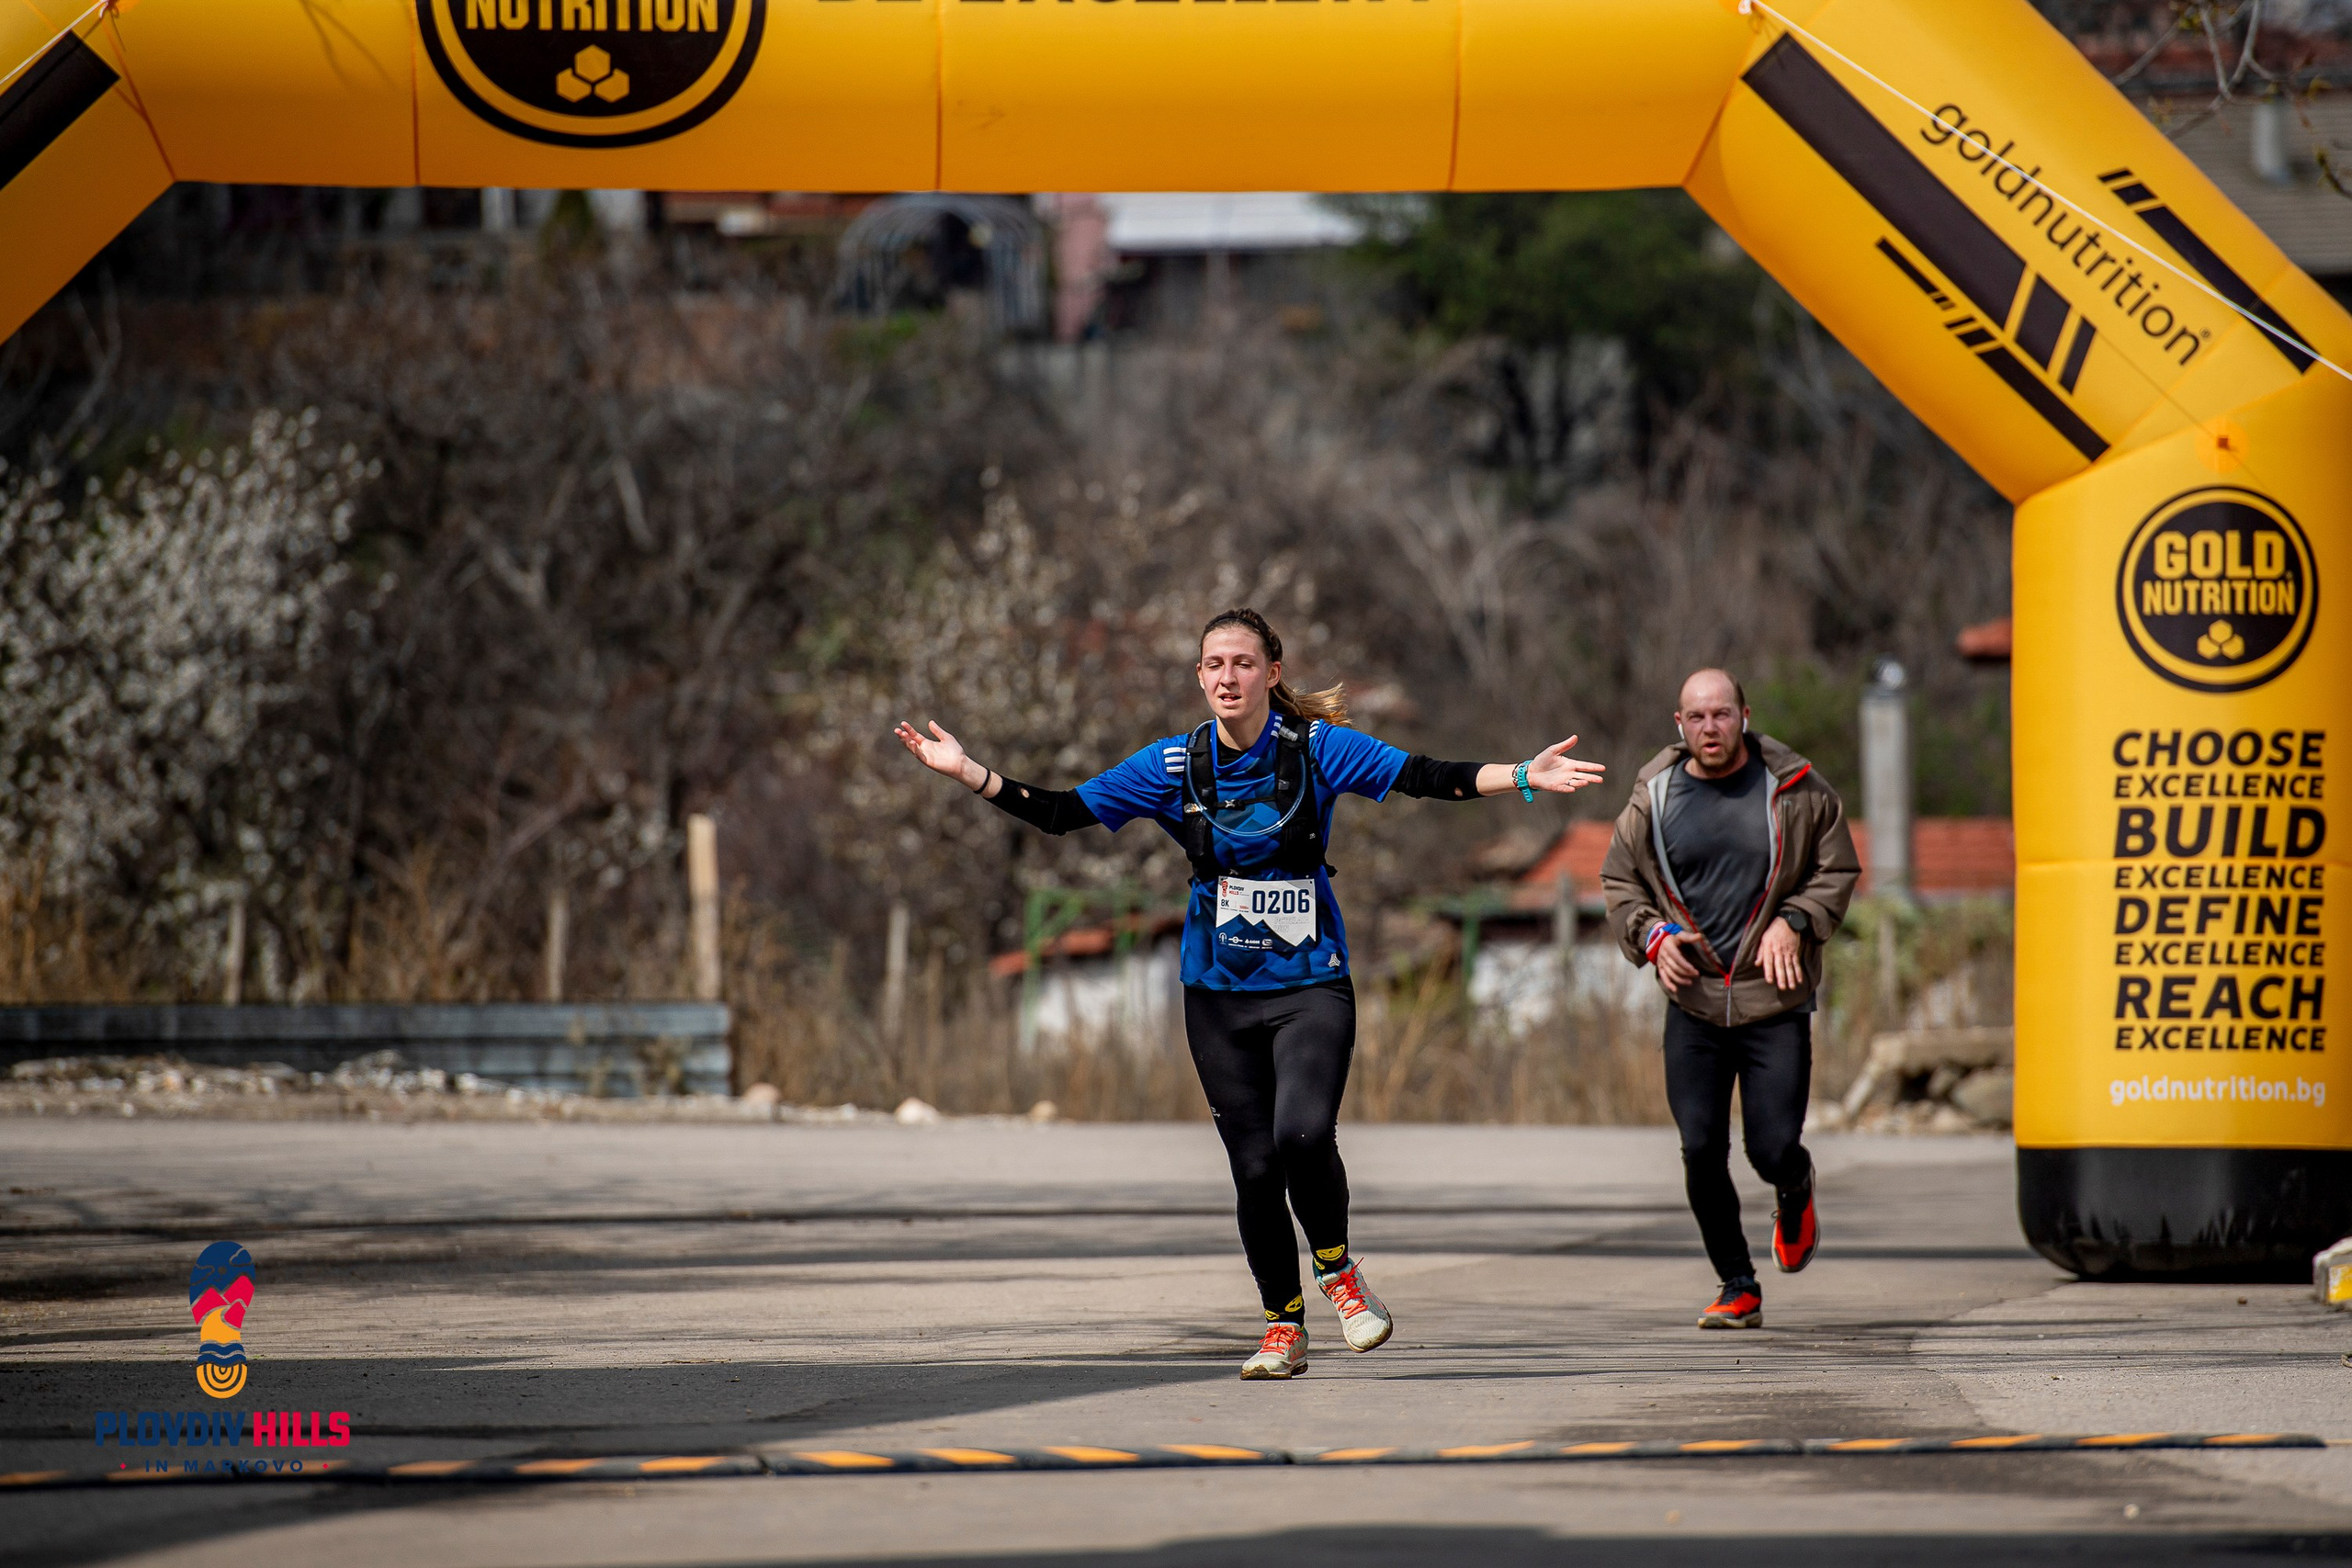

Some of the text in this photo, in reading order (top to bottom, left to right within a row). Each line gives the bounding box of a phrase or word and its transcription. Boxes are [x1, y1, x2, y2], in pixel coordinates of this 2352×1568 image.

[2154, 530, 2286, 580] GOLD
[2143, 580, 2296, 615] NUTRITION
[2113, 729, 2327, 769] CHOOSE
[2114, 773, 2326, 798] EXCELLENCE
[2113, 805, 2327, 860] BUILD
[2114, 863, 2325, 889] EXCELLENCE
[1220, 898, 1230, 908] 8K
[1252, 888, 1310, 915] 0206
[2114, 895, 2325, 937] DEFINE
[2115, 941, 2326, 966] EXCELLENCE
[2115, 974, 2326, 1021] REACH
[2115, 1025, 2327, 1052] EXCELLENCE
[2109, 1076, 2326, 1107] goldnutrition.bg
